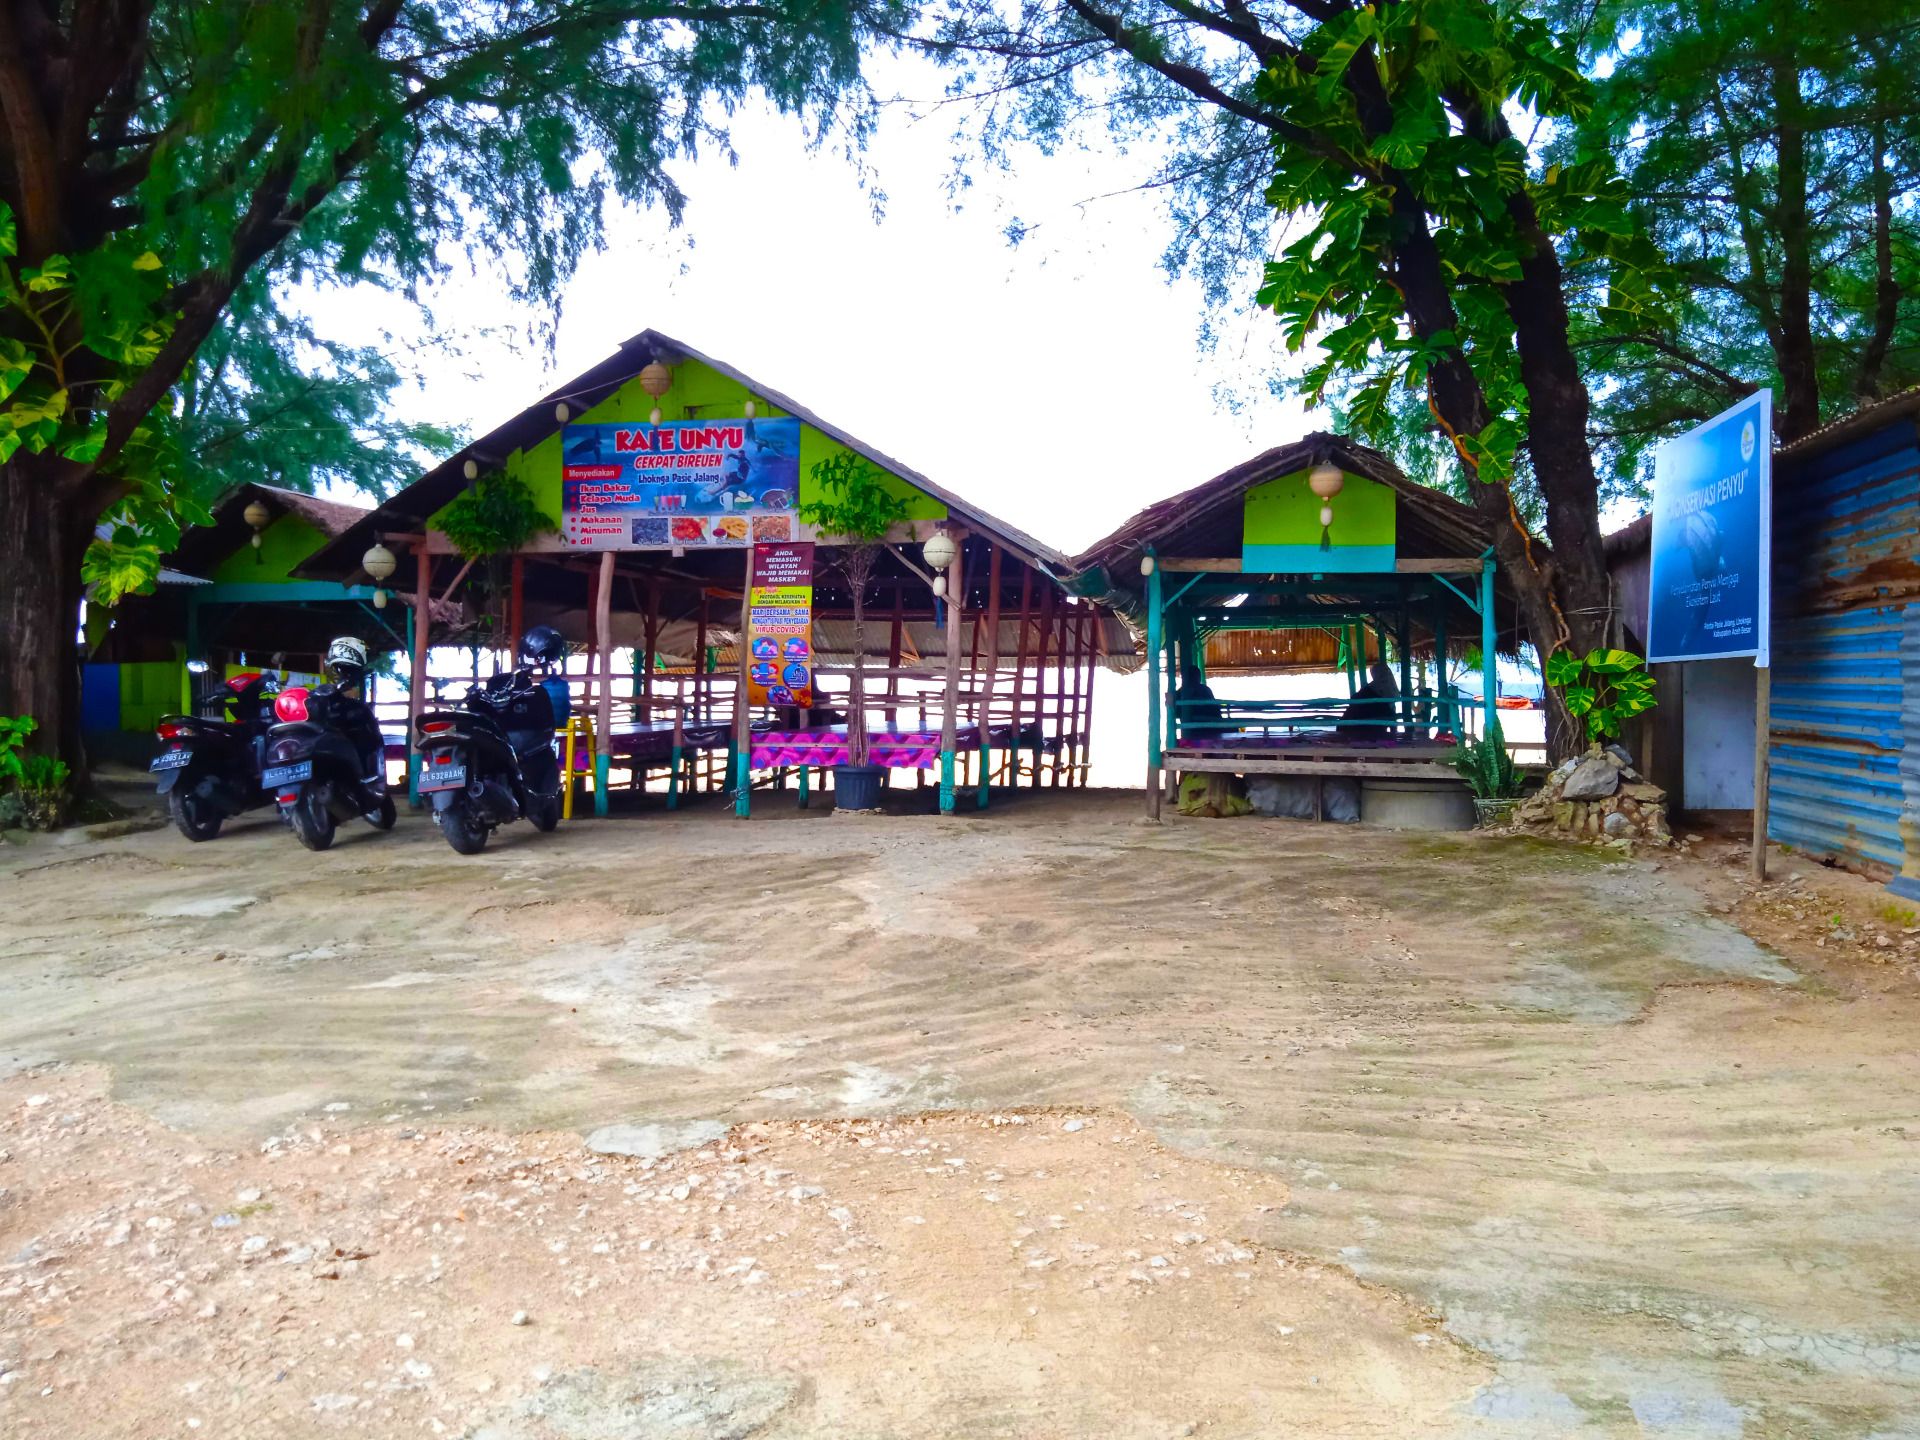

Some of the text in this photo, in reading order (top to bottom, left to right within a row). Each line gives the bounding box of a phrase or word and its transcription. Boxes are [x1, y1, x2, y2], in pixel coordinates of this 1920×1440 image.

[680, 427, 744, 451] UNYU
[676, 453, 723, 469] BIREUEN
[568, 470, 615, 479] Menyediakan
[638, 474, 669, 485] Lhoknga
[693, 472, 720, 484] Jalang
[580, 483, 631, 493] Ikan Bakar
[580, 493, 641, 505] Kelapa Muda
[580, 505, 597, 514] Jus
[580, 515, 623, 524] Makanan
[580, 526, 623, 535] Minuman
[580, 537, 593, 545] dll
[776, 626, 805, 634] COVID-19
